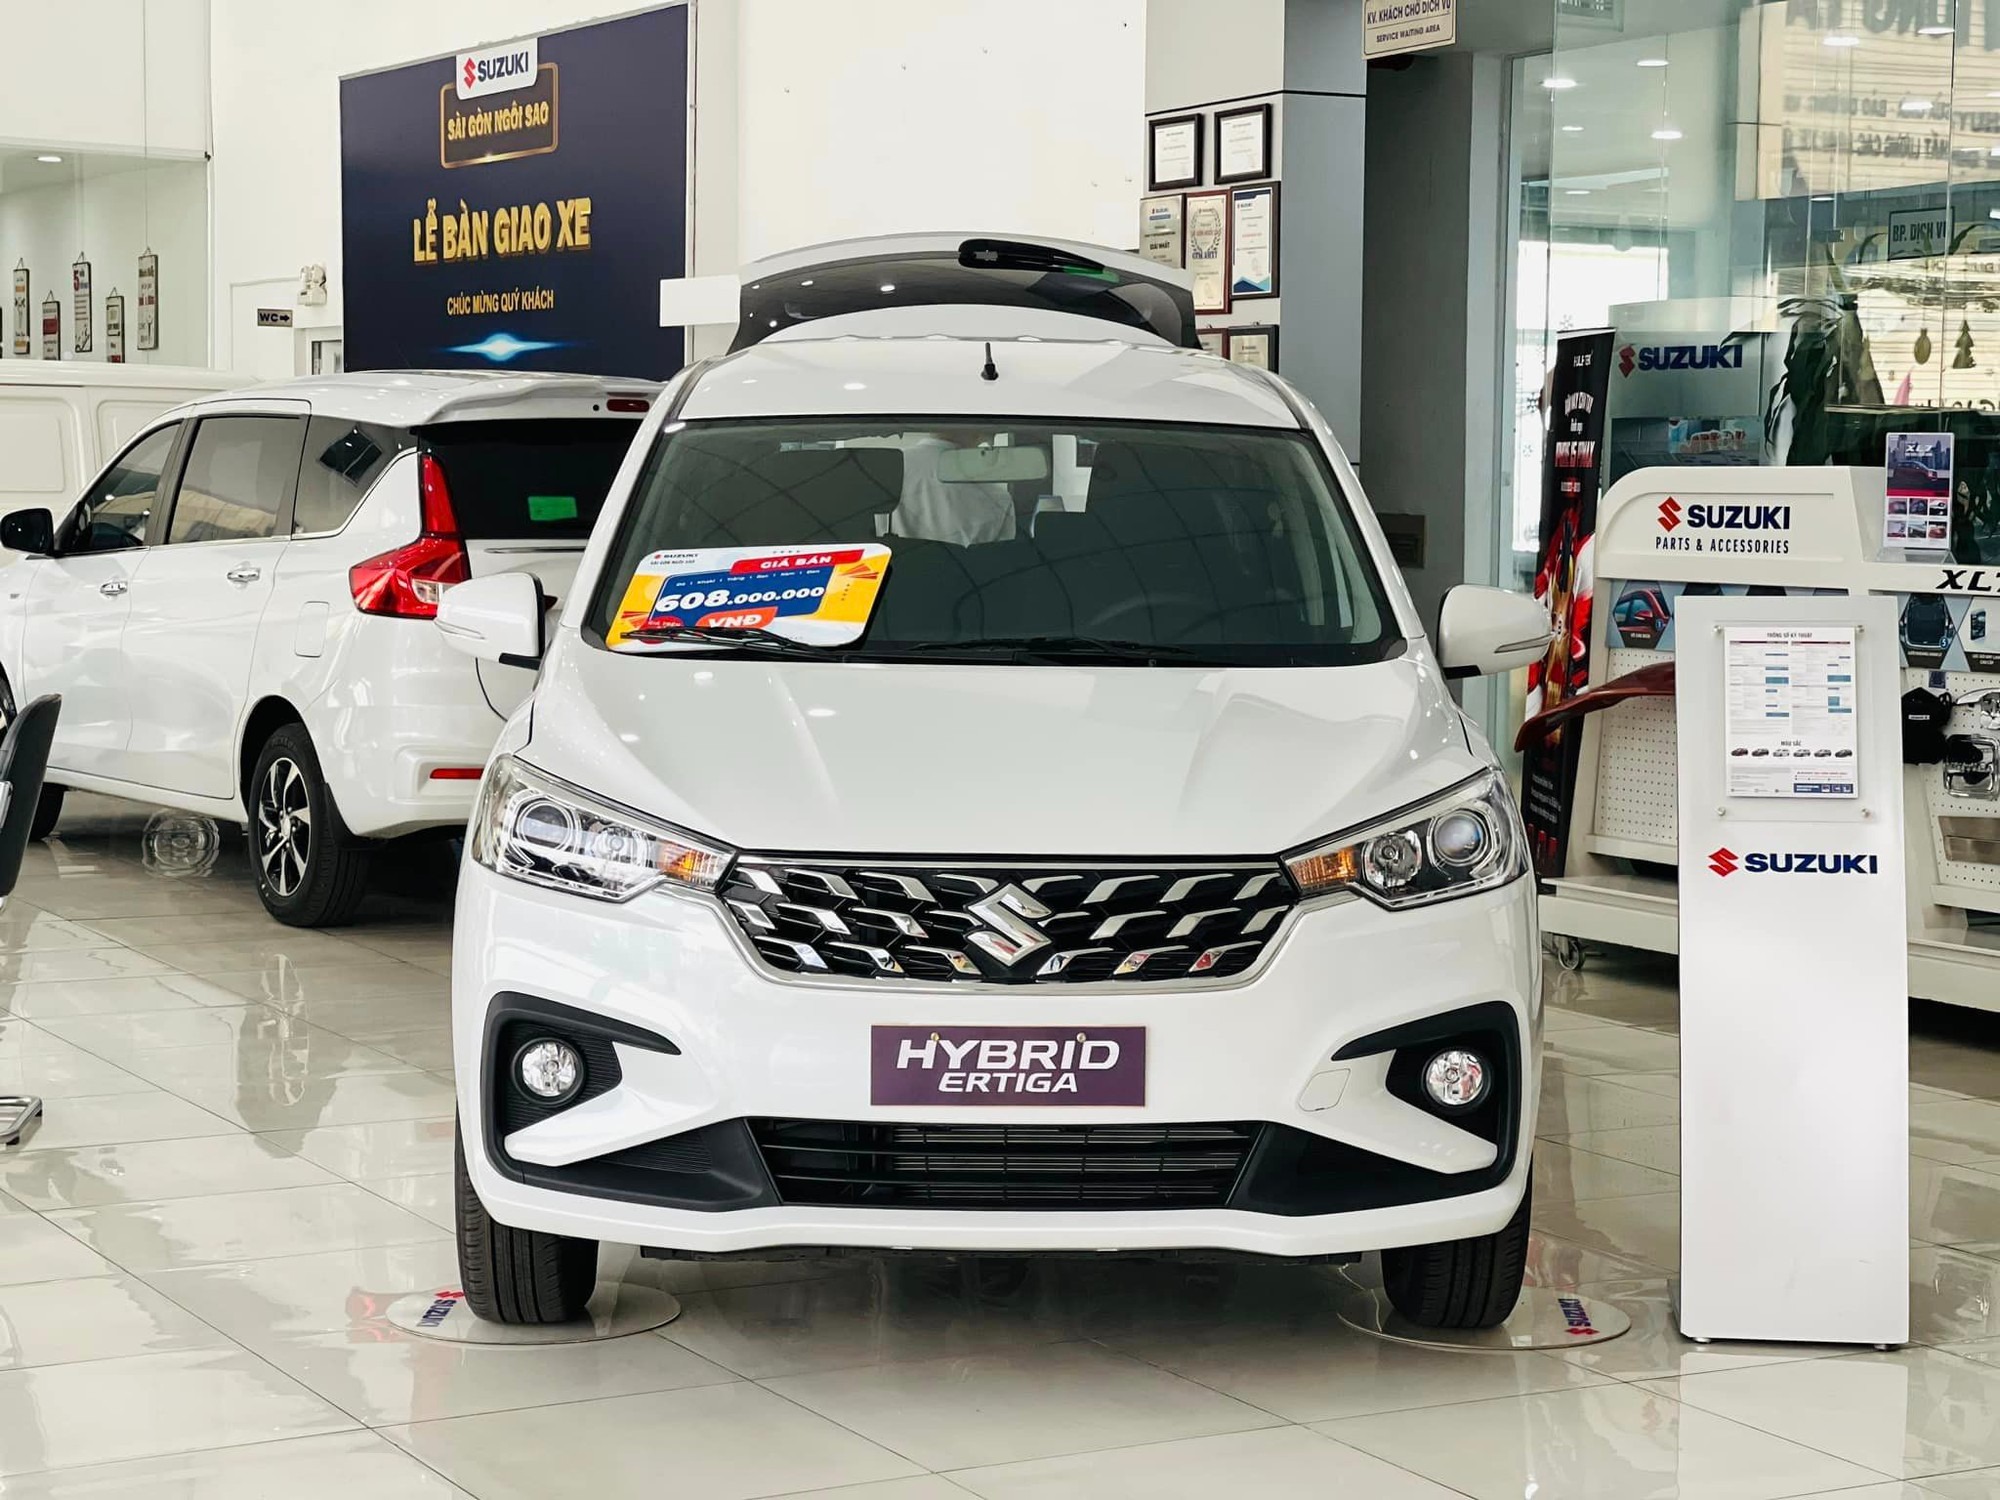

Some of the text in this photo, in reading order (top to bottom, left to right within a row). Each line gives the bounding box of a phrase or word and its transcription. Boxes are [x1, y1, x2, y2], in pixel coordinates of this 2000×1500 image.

[1379, 5, 1403, 21] KHÁCH
[1404, 1, 1421, 17] CHỜ
[1376, 24, 1440, 42] SERVICE WAITING AREA
[478, 51, 529, 82] SUZUKI
[447, 100, 549, 140] SÀI GÒN NGÔI SAO
[413, 197, 592, 263] LỄ BÀN GIAO XE
[1892, 224, 1908, 242] BP.
[74, 270, 80, 291] 5
[447, 285, 554, 316] CHÚC MỪNG QUÝ KHÁCH
[259, 313, 279, 322] WC
[1638, 344, 1743, 371] SUZUKI
[1687, 504, 1791, 530] SUZUKI
[1655, 536, 1790, 554] PARTS & ACCESSORIES
[760, 555, 832, 569] GIÁ BÁN
[1935, 569, 2000, 592] XL
[654, 585, 826, 613] 608.000.000
[709, 613, 763, 628] VNĐ
[1744, 853, 1878, 874] SUZUKI
[897, 1039, 1120, 1070] HYBRID
[938, 1072, 1078, 1093] ERTIGA
